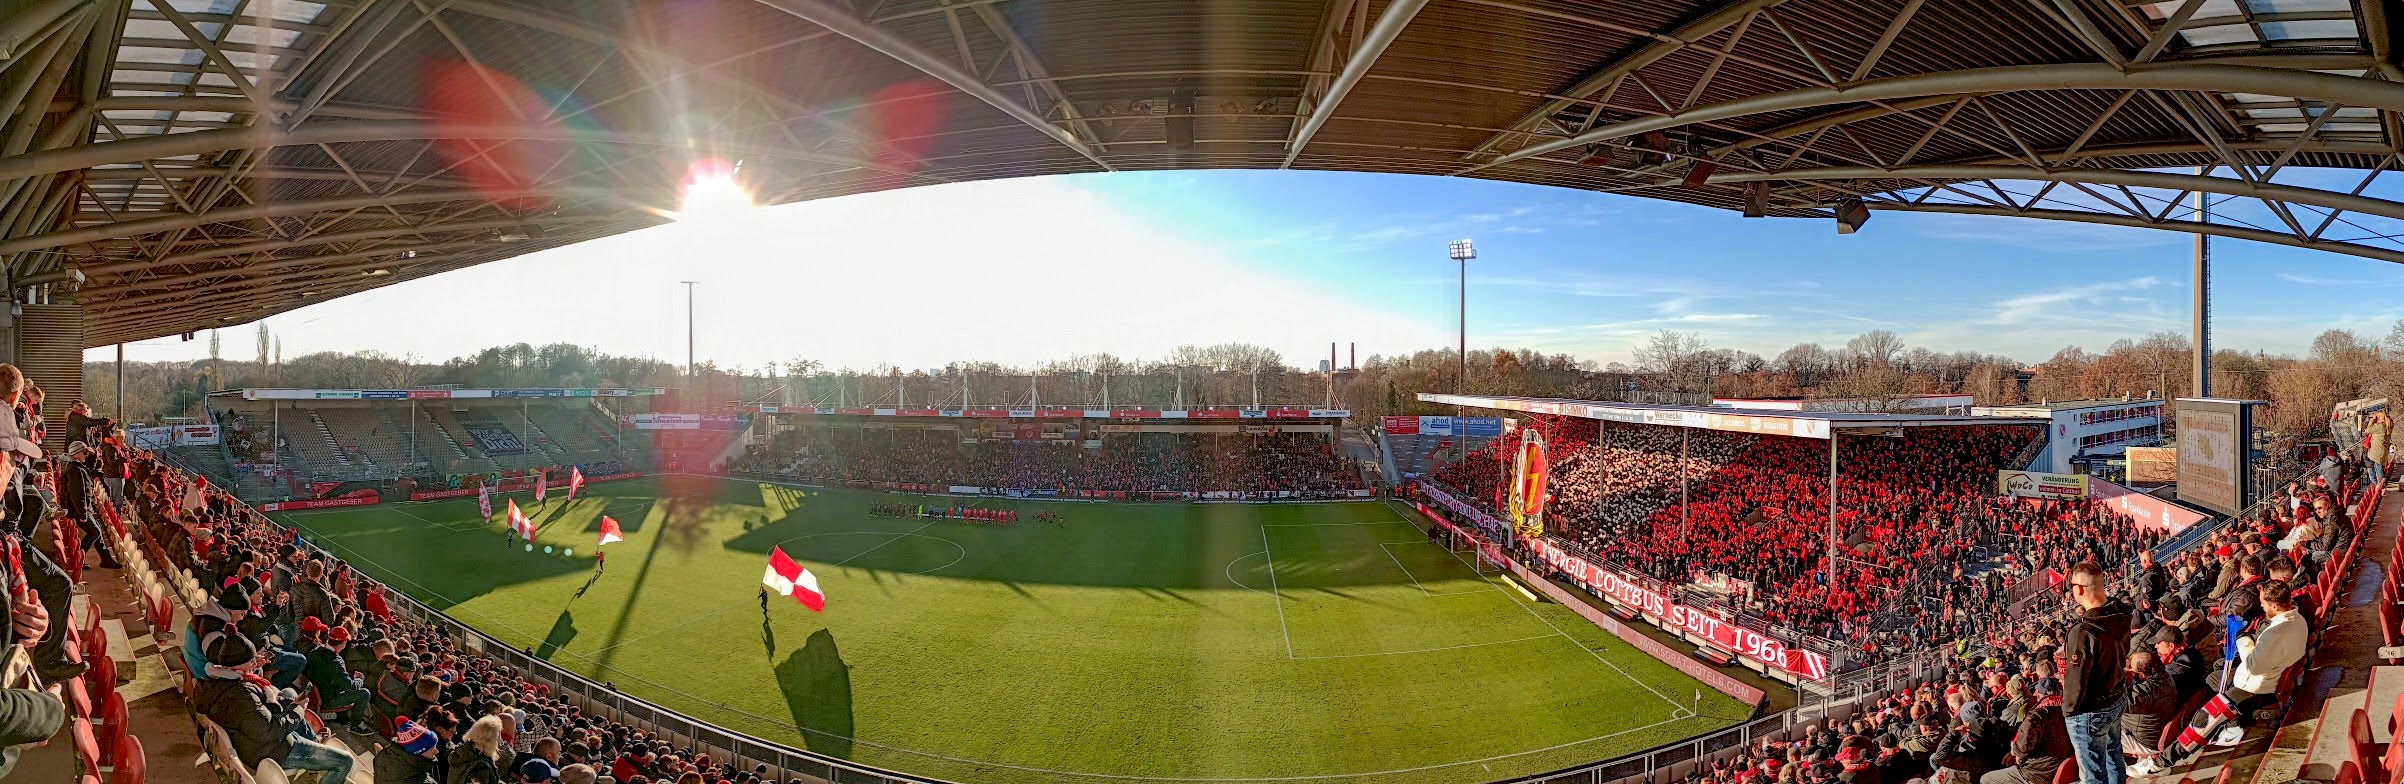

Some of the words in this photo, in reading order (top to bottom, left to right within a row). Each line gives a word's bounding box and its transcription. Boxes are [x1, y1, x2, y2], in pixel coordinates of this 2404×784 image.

[1431, 416, 1449, 424] ahod
[325, 498, 363, 506] GASTGEBER
[1542, 543, 1588, 579] ENERGIE
[1595, 570, 1665, 617] COTTBUS
[1672, 605, 1719, 641] SEIT
[1733, 628, 1788, 669] 1966
[1638, 636, 1750, 699] WWW.SORAT-HOTELS.COM
